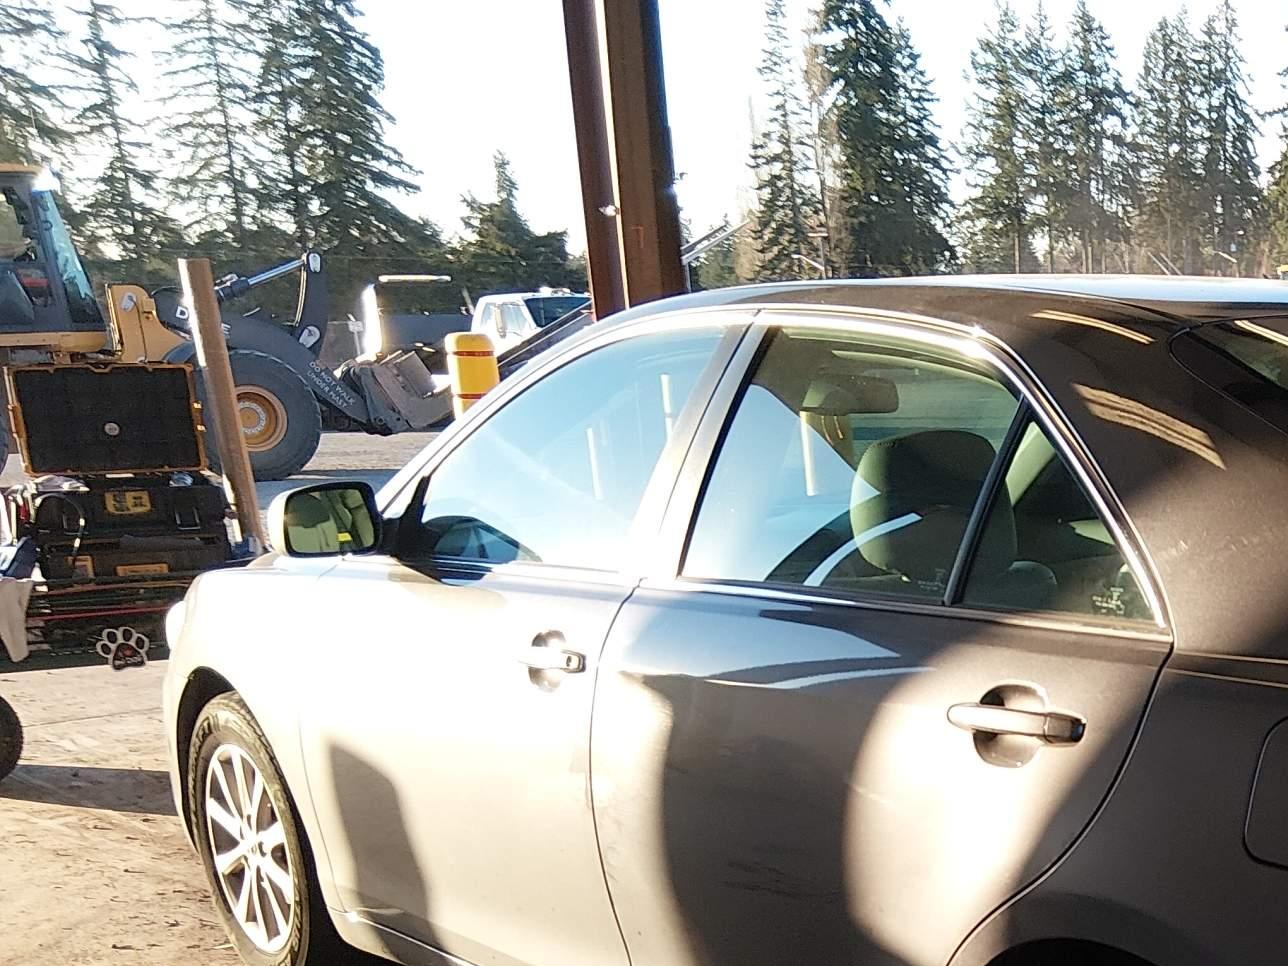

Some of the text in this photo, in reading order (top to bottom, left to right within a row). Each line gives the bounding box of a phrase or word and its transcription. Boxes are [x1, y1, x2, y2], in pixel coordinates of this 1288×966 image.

[307, 371, 330, 392] UNDER
[309, 361, 354, 406] DO NOT WALK
